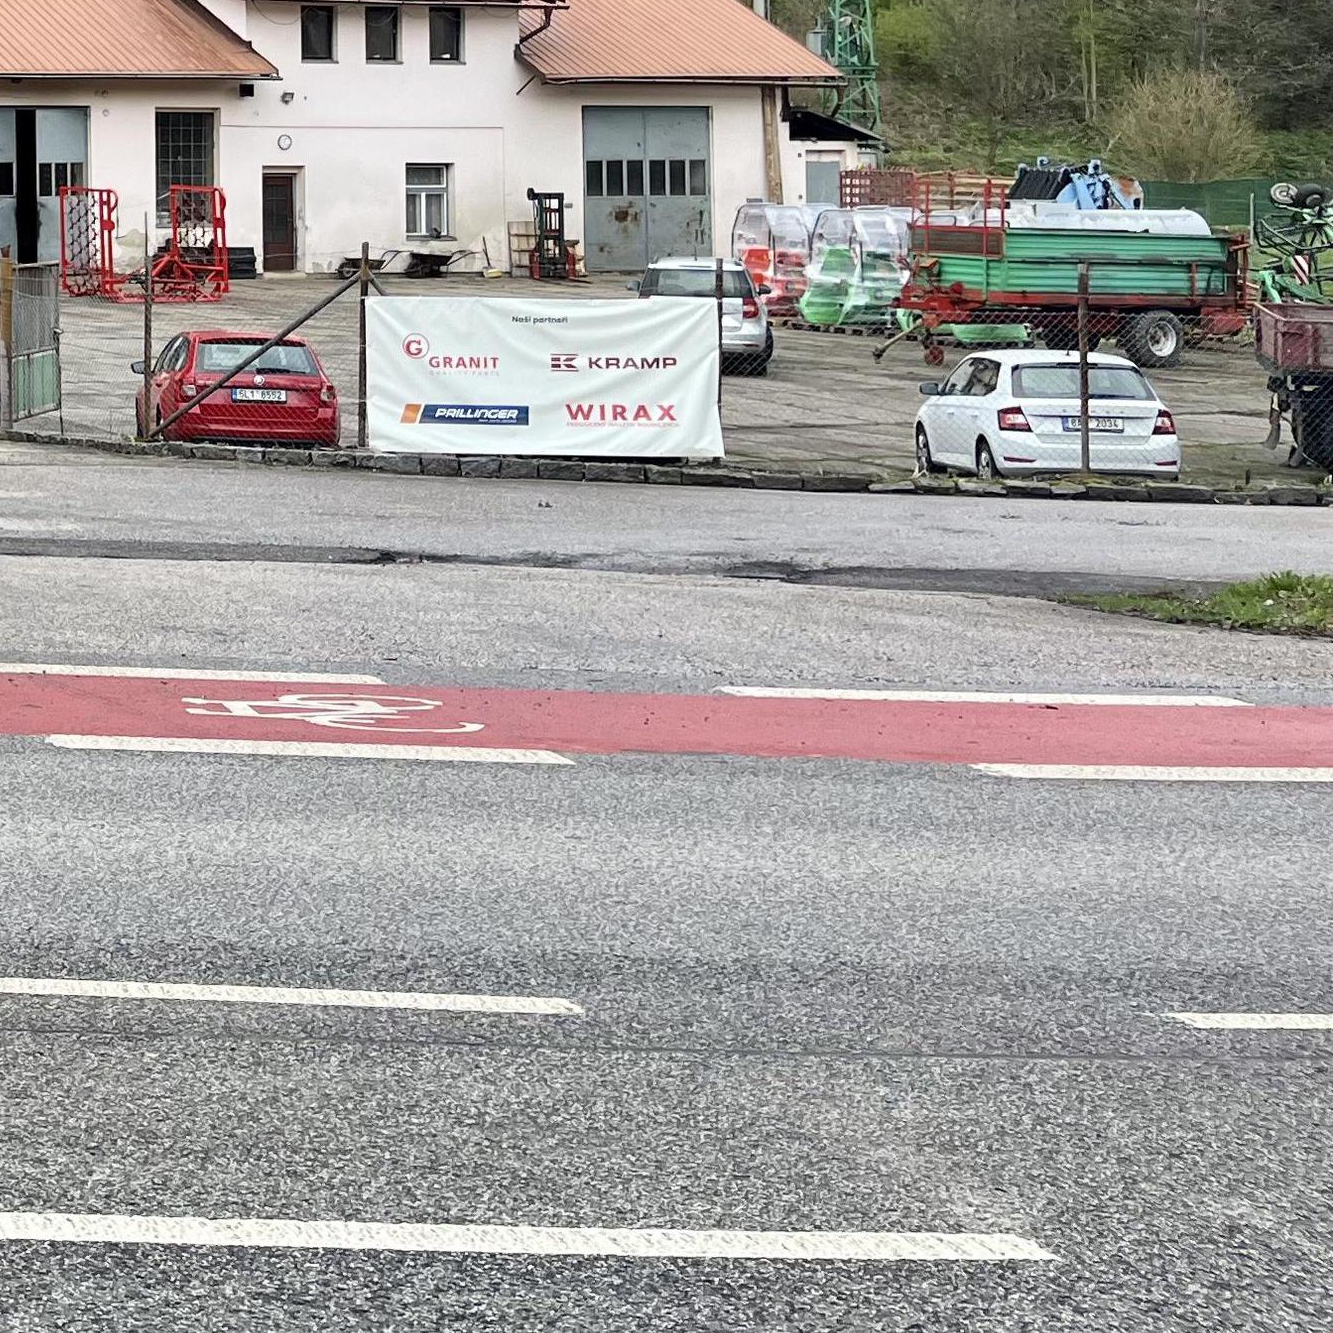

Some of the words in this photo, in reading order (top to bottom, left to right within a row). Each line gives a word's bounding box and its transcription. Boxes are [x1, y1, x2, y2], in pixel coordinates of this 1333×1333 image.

[428, 356, 500, 369] GRANIT
[588, 357, 678, 370] KRAMP
[434, 407, 519, 420] PRILLINGER
[565, 404, 677, 422] WIRAX
